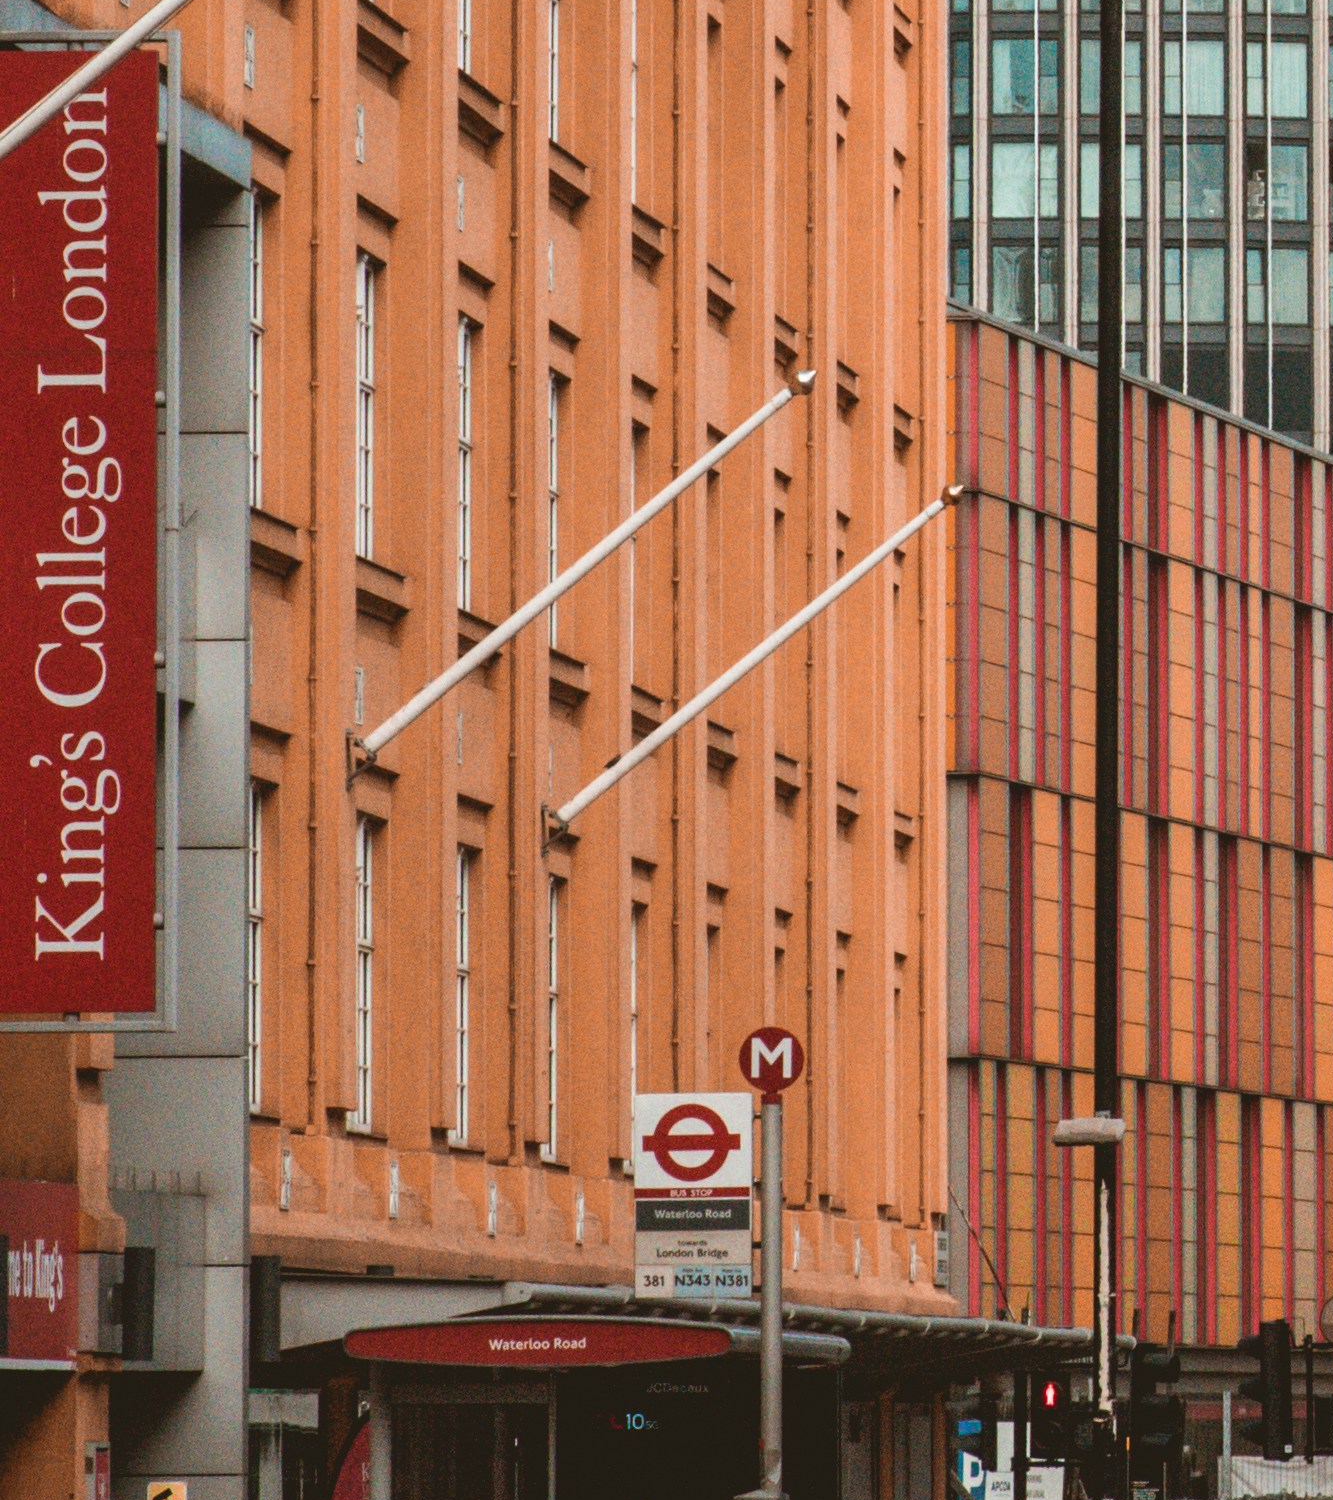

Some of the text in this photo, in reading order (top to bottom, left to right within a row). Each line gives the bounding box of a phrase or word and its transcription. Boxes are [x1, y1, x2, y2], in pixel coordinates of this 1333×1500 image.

[30, 87, 122, 961] King's College London
[750, 1037, 792, 1079] M
[670, 1189, 713, 1198] BUS STOP
[654, 1208, 731, 1219] Waterloo Road
[656, 1248, 729, 1259] London Bridge
[643, 1275, 749, 1287] 381 N343 N381
[489, 1337, 587, 1350] Waterloo Road
